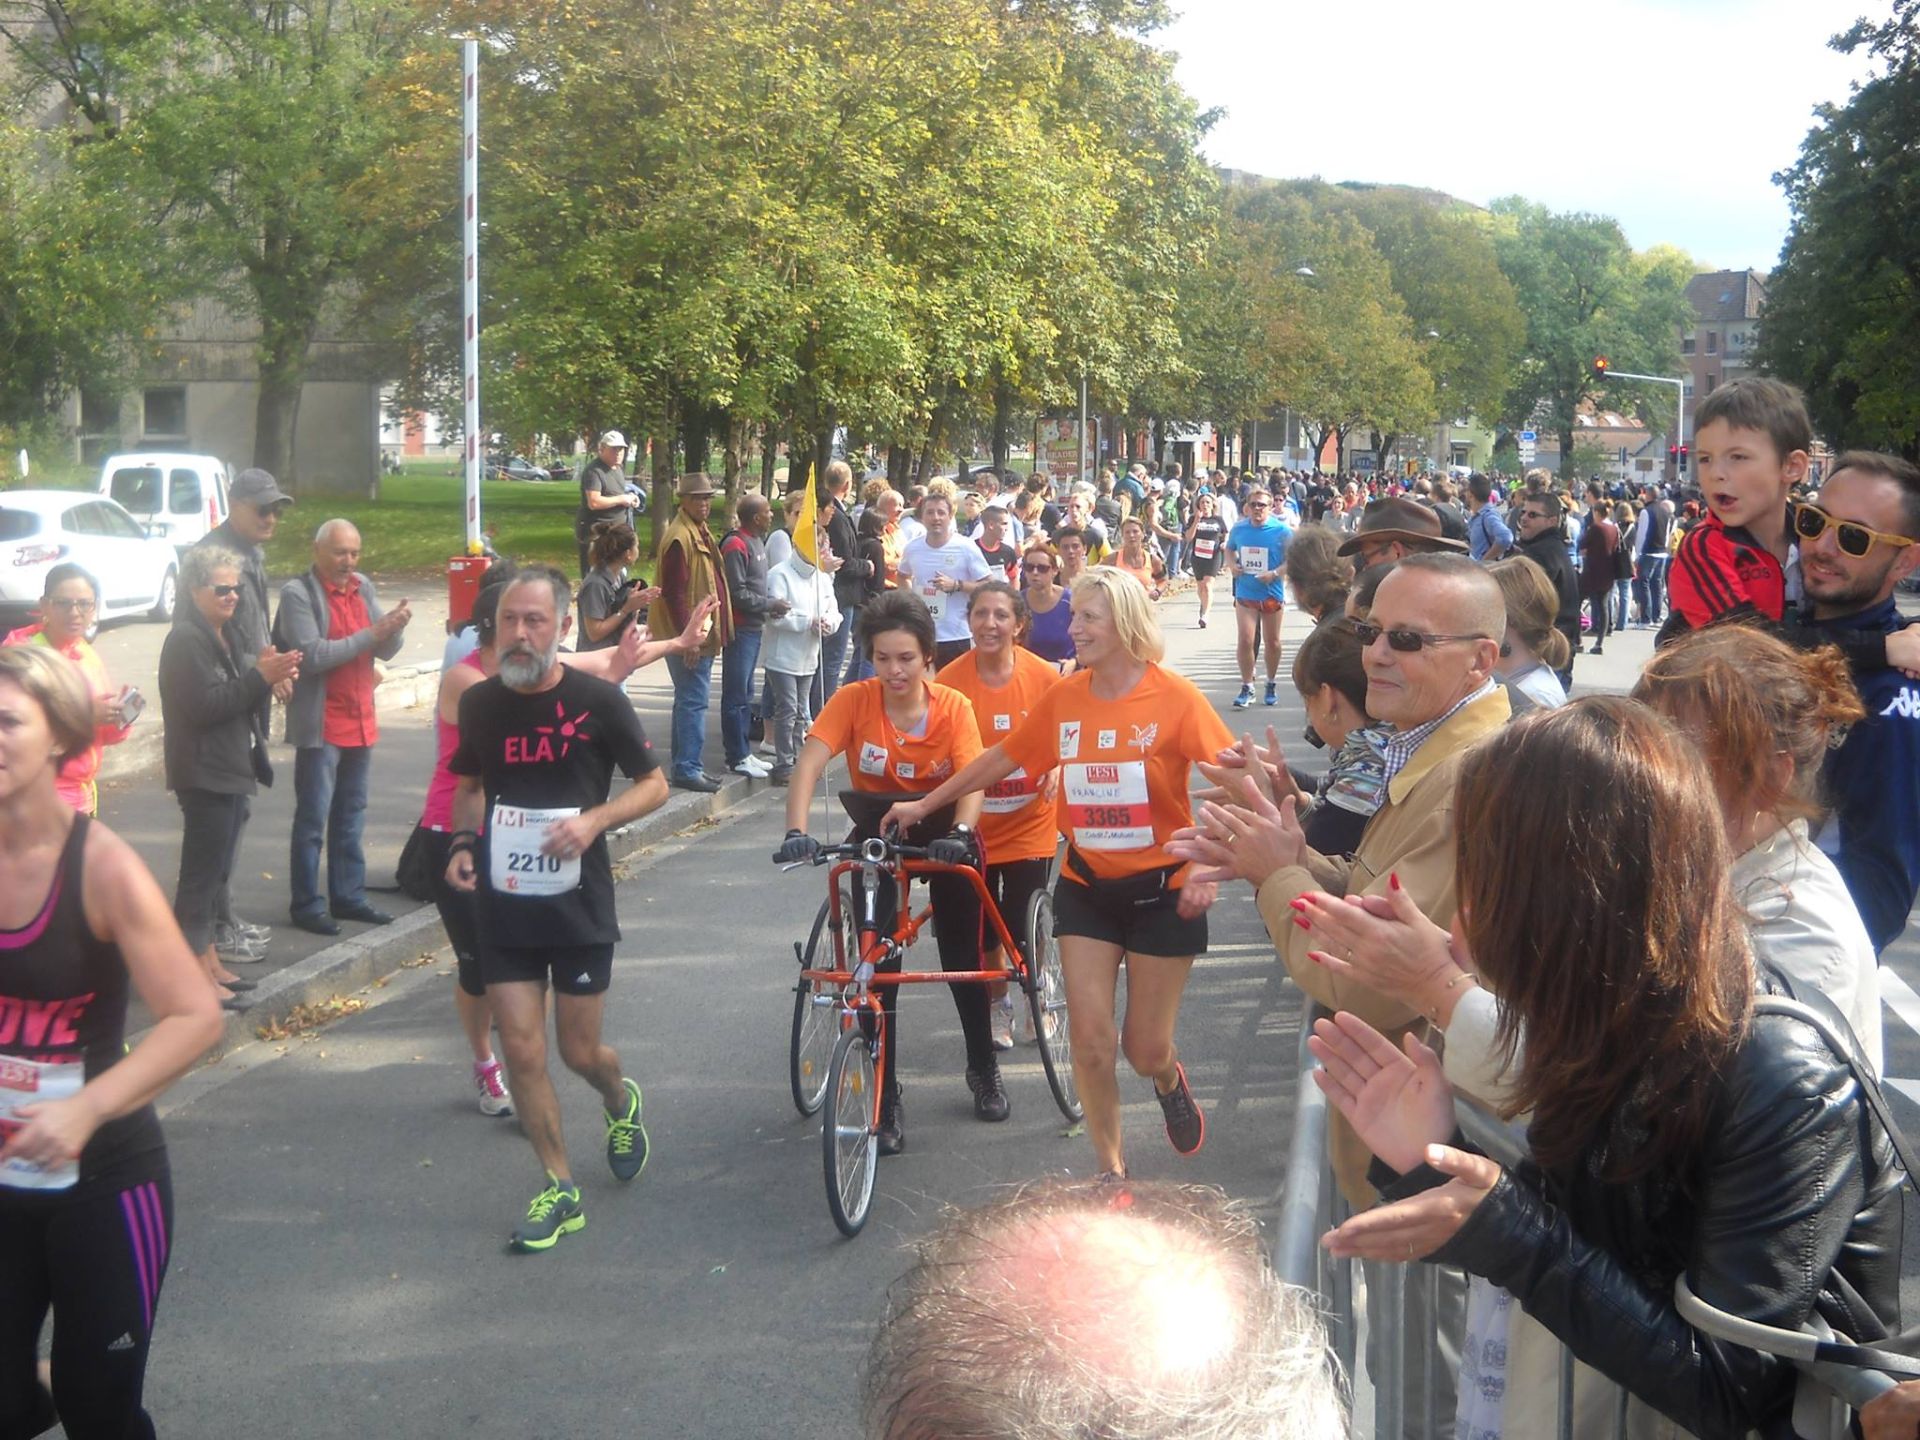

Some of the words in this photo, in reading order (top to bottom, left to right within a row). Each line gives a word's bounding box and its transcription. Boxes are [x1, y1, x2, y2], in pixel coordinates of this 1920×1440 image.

[505, 736, 554, 763] ELA
[1083, 807, 1131, 826] 3365
[507, 852, 561, 873] 2210
